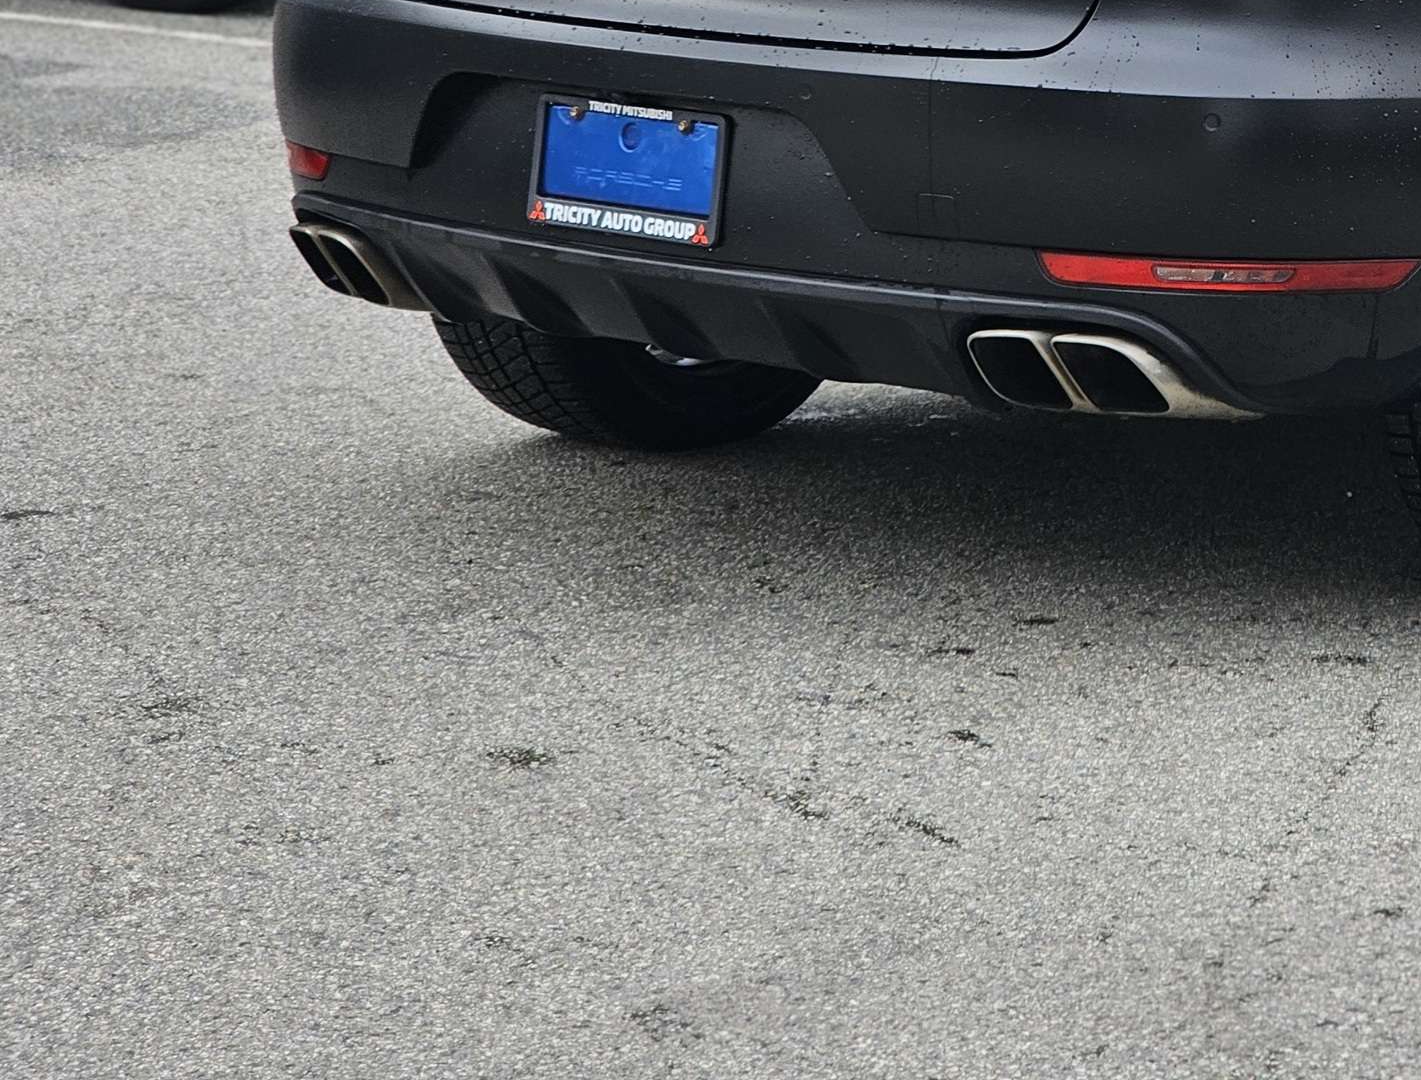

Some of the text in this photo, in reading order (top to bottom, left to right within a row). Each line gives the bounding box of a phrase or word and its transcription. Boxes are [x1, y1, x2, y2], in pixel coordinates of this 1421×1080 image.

[588, 100, 673, 120] TRICITY MITSUBISHI
[544, 201, 697, 241] TRICITY AUTO GROUP
